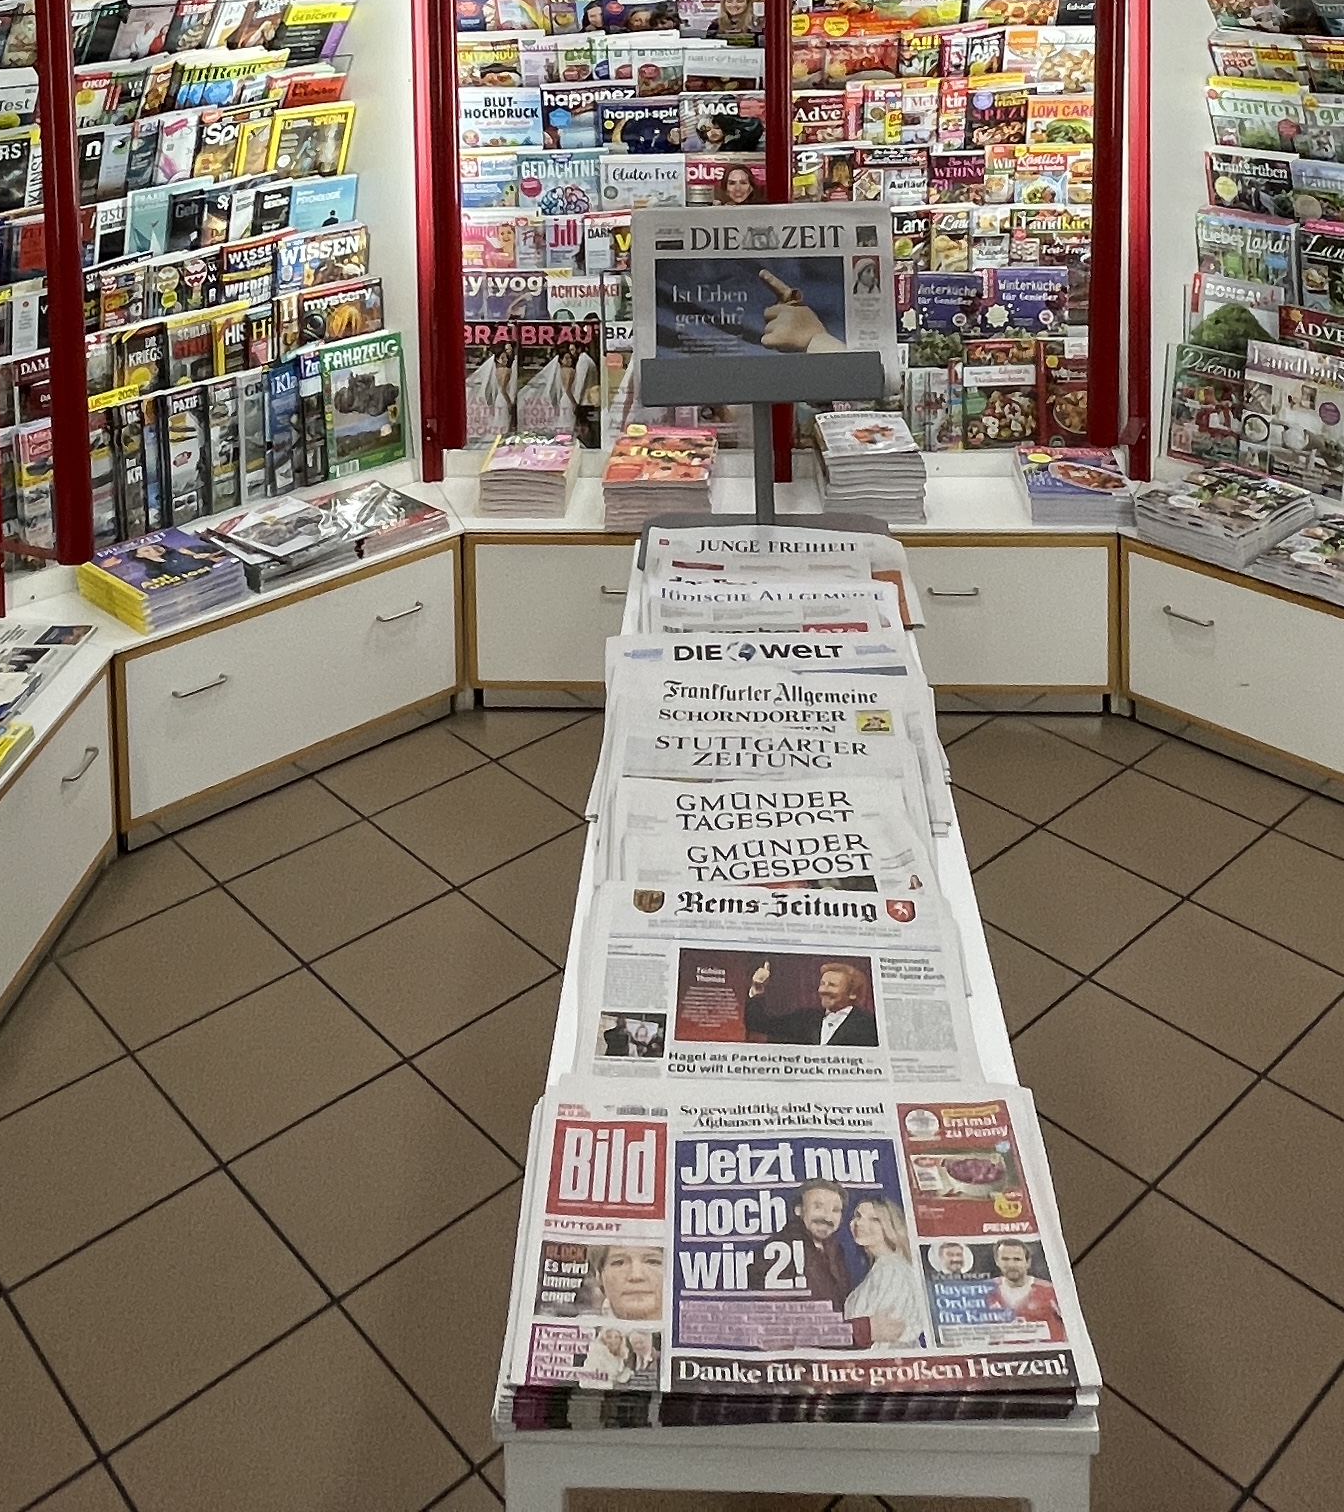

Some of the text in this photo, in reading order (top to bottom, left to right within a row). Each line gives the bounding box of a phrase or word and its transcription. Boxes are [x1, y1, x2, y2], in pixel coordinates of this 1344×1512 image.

[484, 96, 518, 109] BLUT-
[543, 89, 636, 107] happinez
[464, 107, 539, 119] HOCHDRUCK
[1031, 102, 1058, 118] LOW
[686, 166, 724, 181] plus
[690, 225, 845, 251] DIE ZEIT
[280, 236, 361, 266] WISSEN
[304, 288, 372, 312] mystery
[324, 340, 399, 371] FAHRZEUG
[628, 446, 695, 458] flow
[696, 539, 857, 553] JUNGE FREIHEIT
[673, 644, 723, 661] DIE
[663, 680, 878, 706] Frankfurter Allgemeine
[658, 708, 847, 723] SCHORNDORFER
[655, 736, 868, 756] STUTTGARTER
[692, 752, 833, 769] ZEITUNG
[675, 791, 852, 812] GMÜNDER
[676, 809, 854, 832] TAGESPOST
[686, 833, 871, 864] GMÜNDER
[688, 853, 873, 882] TAGESPOST
[674, 891, 879, 923] Rems-Zeitung
[667, 1064, 696, 1073] CDU
[727, 1065, 780, 1075] Lehrern
[784, 1066, 824, 1075] Druck
[559, 1127, 656, 1204] Bild
[680, 1142, 880, 1184] Jetzt nur
[680, 1190, 787, 1235] noch
[544, 1219, 622, 1233] STUTTGART
[679, 1240, 807, 1289] wir 2!
[678, 1354, 1070, 1387] Danke für Ihre großen Herzen!
